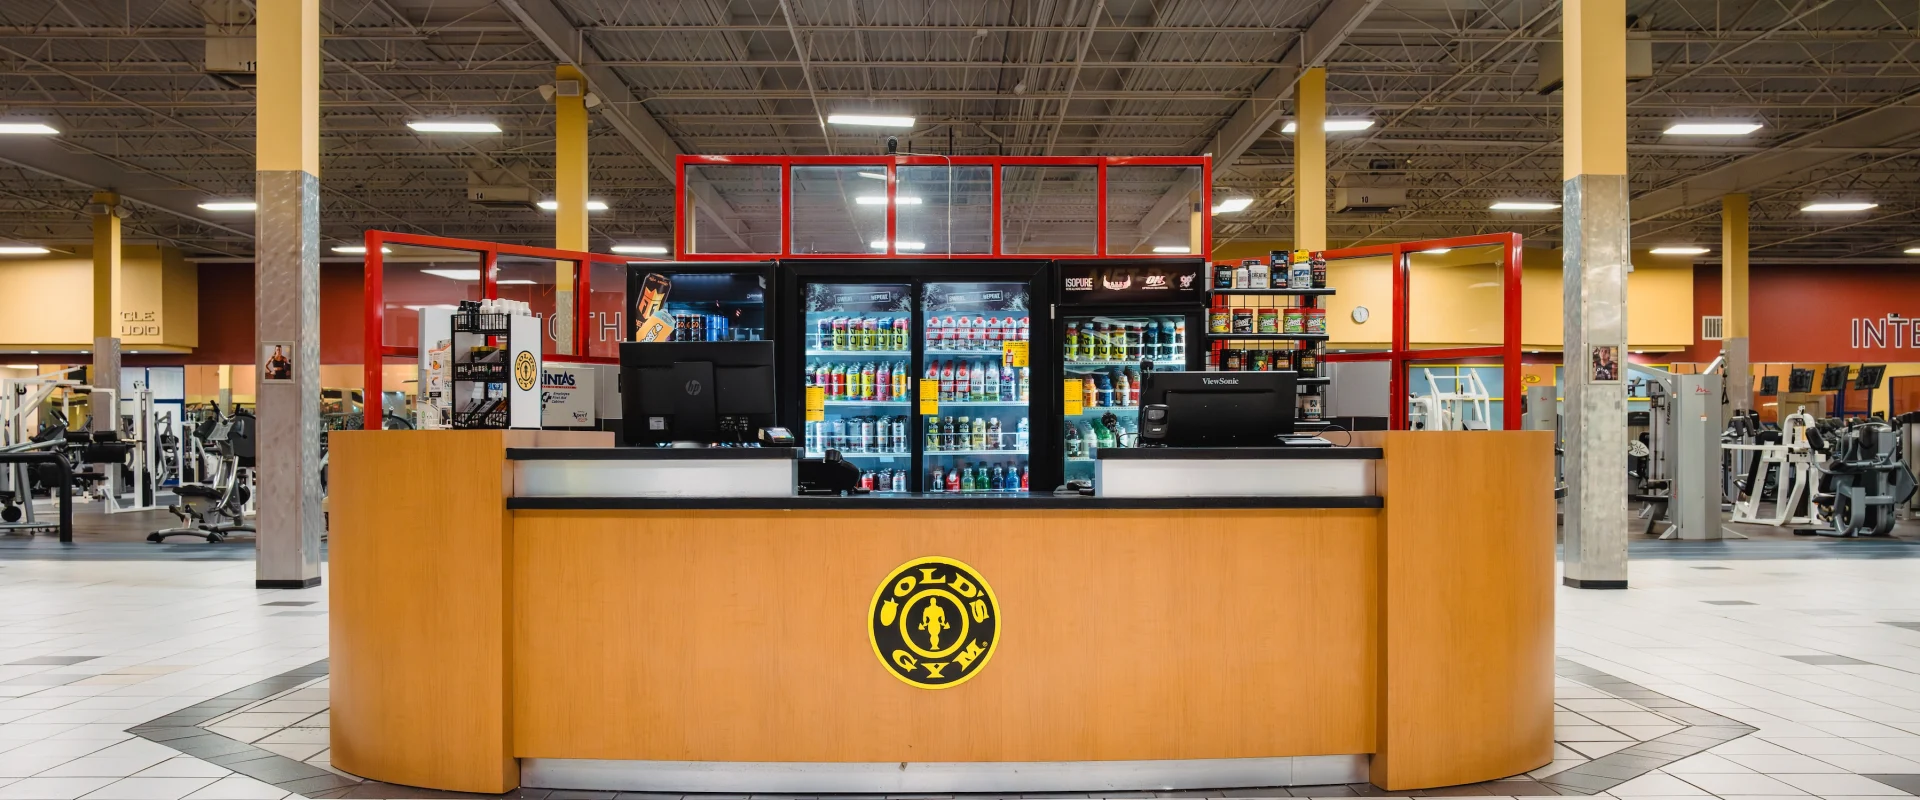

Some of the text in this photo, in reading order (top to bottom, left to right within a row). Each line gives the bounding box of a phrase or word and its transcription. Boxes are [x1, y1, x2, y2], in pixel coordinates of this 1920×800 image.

[1066, 278, 1093, 287] ISOPURE
[120, 312, 154, 321] CLE
[122, 326, 159, 336] UDIO
[542, 370, 576, 385] iNTAS
[880, 568, 989, 626] GOLD'S
[892, 638, 986, 678] GYM
